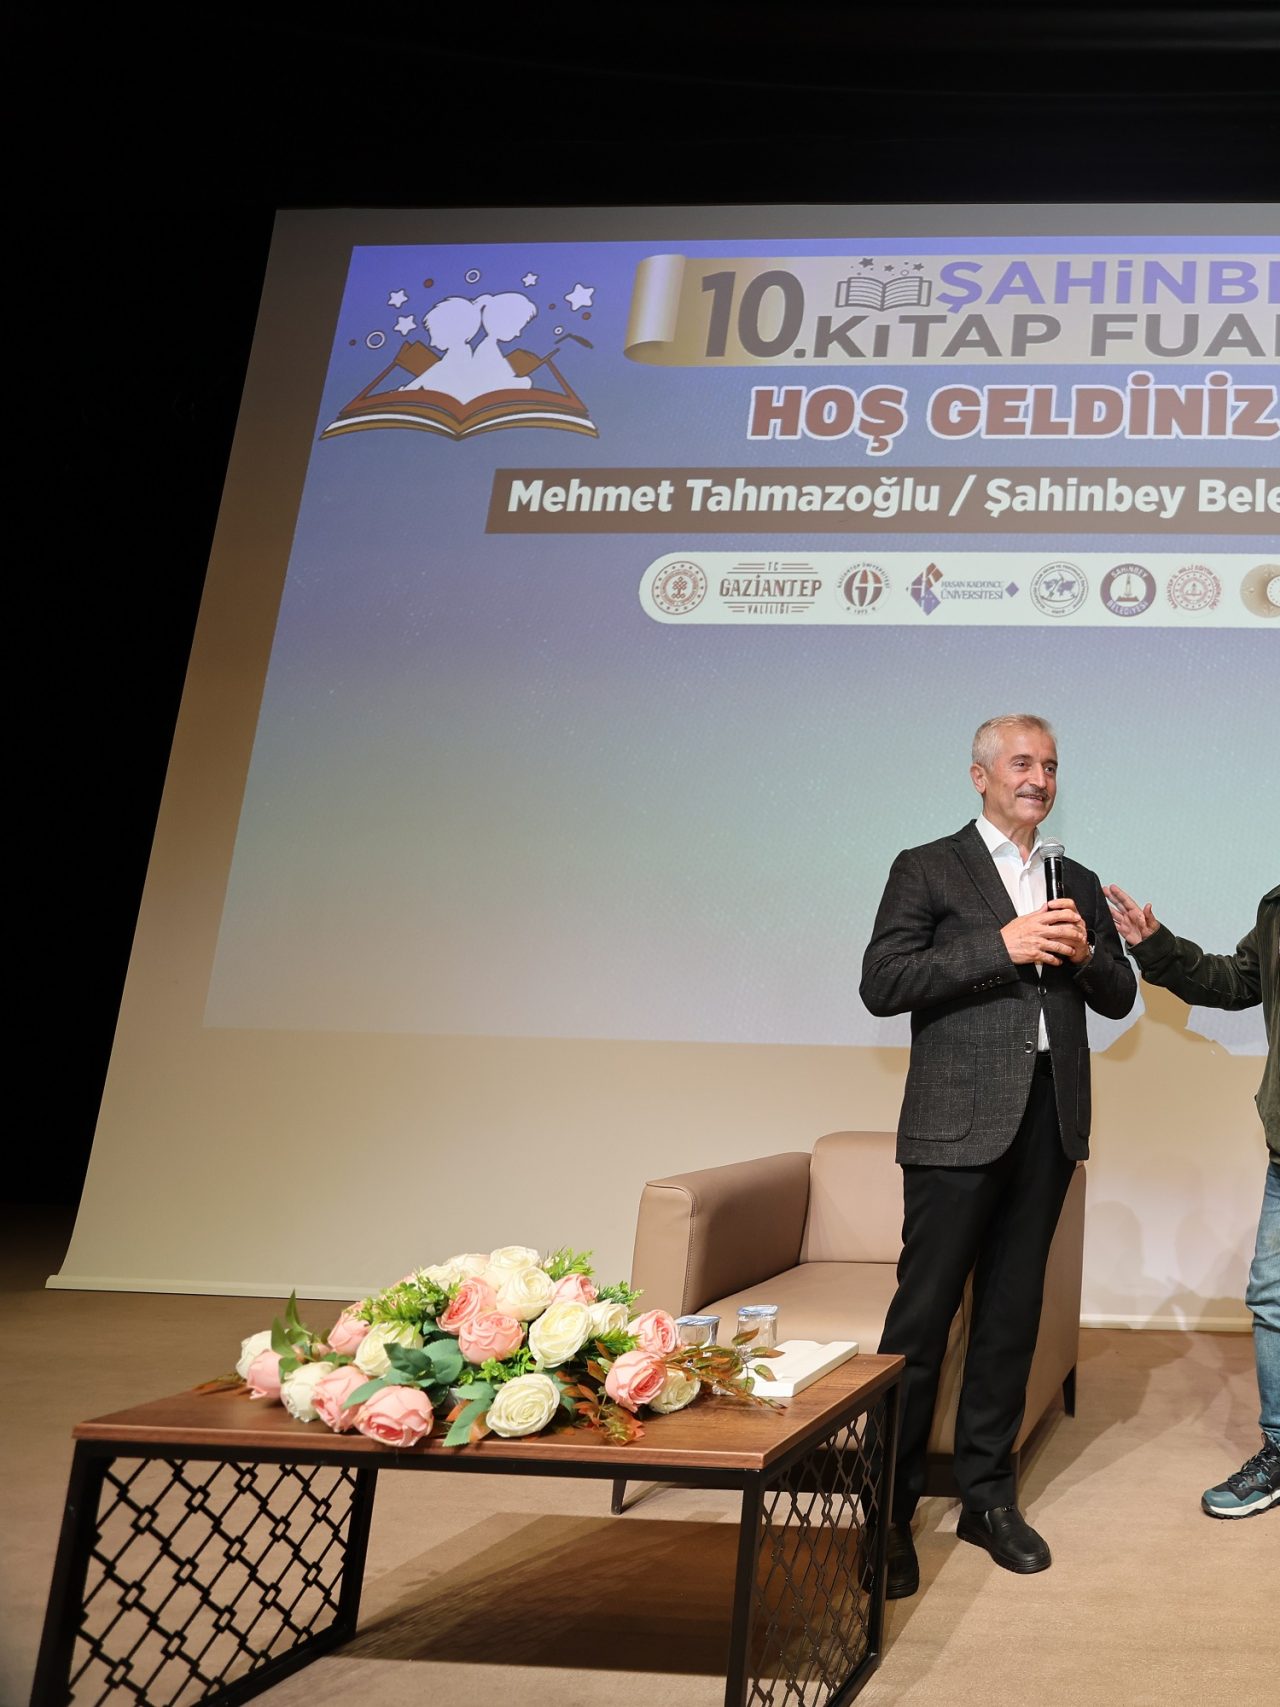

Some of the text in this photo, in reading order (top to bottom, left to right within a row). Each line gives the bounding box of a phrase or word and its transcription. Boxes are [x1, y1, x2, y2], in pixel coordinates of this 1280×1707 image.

[747, 385, 907, 456] HOŞ
[507, 479, 673, 513] Mehmet
[685, 476, 940, 518] Tahmazoğlu
[948, 474, 977, 517] /
[983, 477, 1187, 519] Şahinbey
[719, 573, 823, 597] GAZİANTEP
